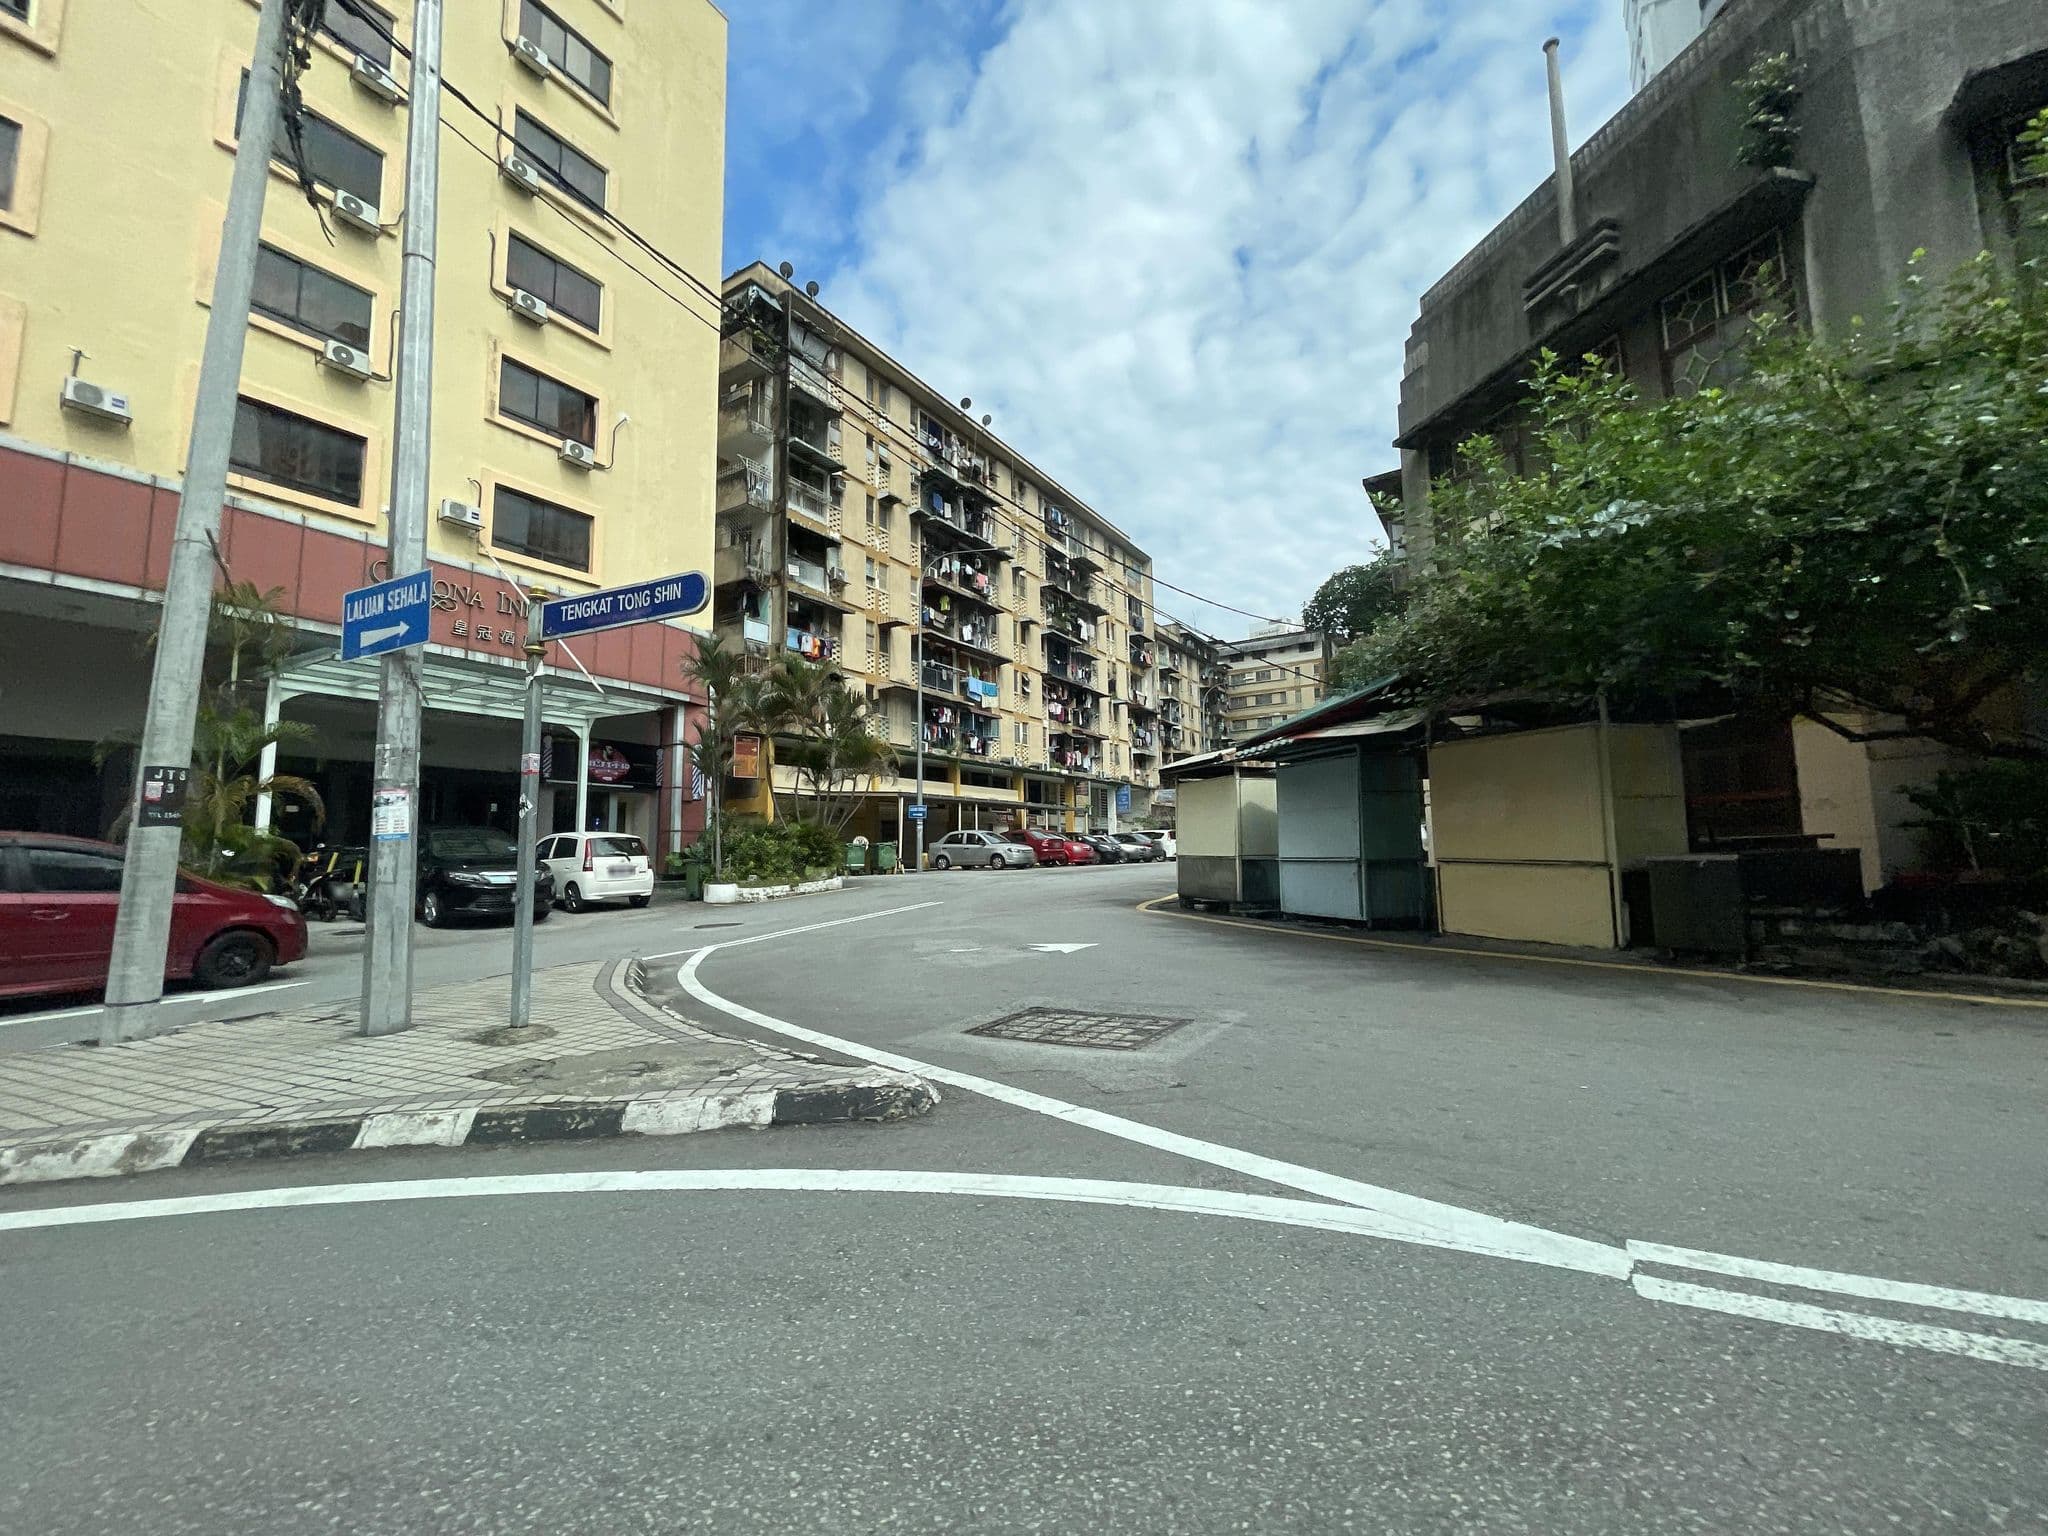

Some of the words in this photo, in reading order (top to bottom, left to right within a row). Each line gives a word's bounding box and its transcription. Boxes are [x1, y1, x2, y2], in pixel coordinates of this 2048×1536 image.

[346, 593, 384, 622] LALUAN
[387, 581, 427, 611] SEHALA
[561, 597, 613, 621] TENGKAT
[618, 591, 650, 611] TONG
[654, 583, 682, 604] SHIN
[452, 619, 529, 648] 皇冠酒
